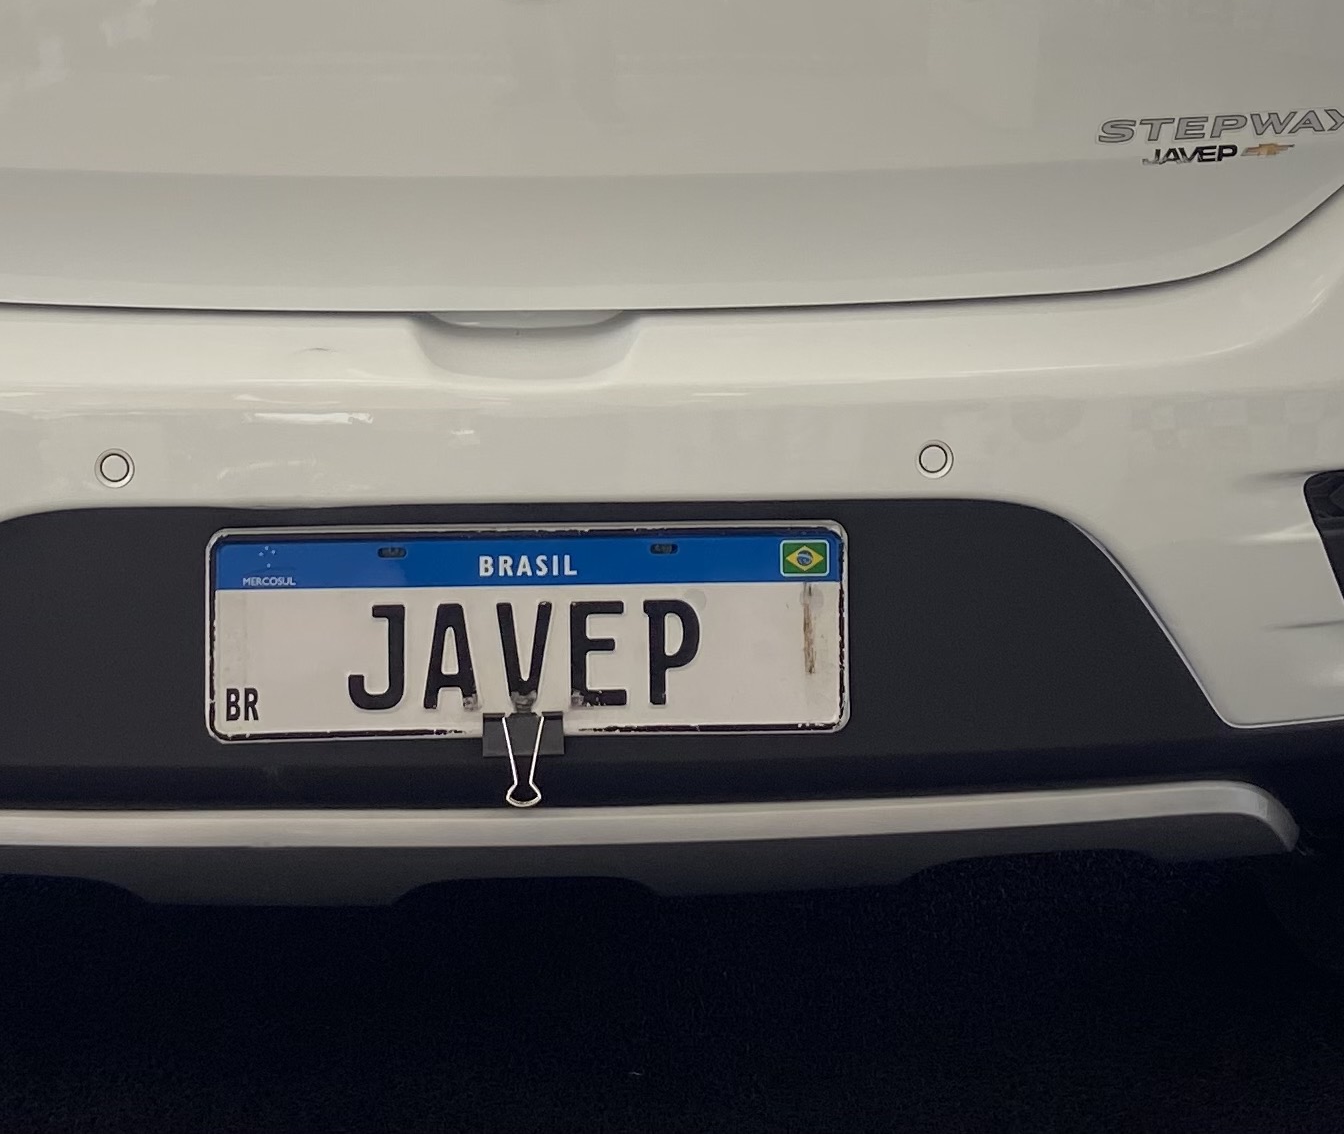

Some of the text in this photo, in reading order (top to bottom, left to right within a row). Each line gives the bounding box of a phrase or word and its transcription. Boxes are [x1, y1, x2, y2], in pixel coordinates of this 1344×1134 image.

[1142, 144, 1238, 166] JAVEP
[479, 554, 578, 577] BRASIL
[242, 577, 297, 586] MERCOSUL
[347, 600, 702, 711] JAVEP
[225, 687, 260, 721] BR
